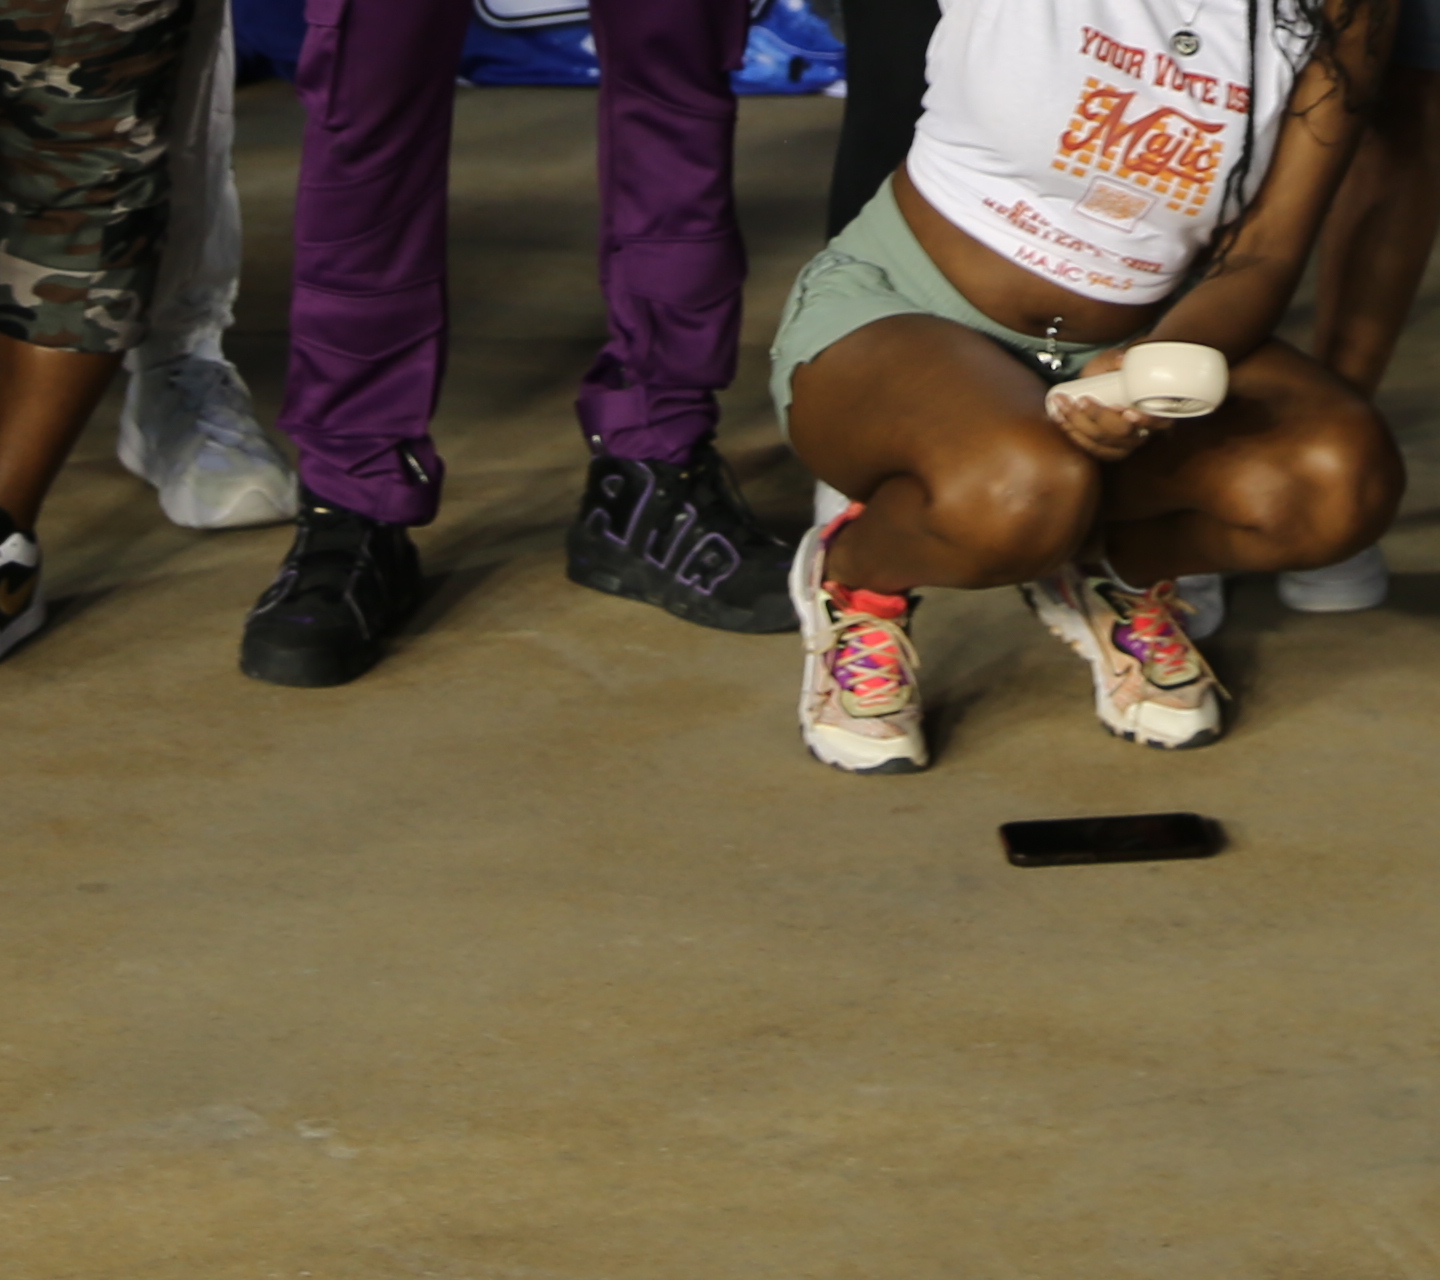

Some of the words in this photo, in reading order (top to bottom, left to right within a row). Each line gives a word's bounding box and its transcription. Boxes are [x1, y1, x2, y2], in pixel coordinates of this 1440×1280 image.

[1078, 25, 1147, 80] YOUR
[1152, 53, 1218, 107] VOTE
[579, 455, 744, 598] AIR
